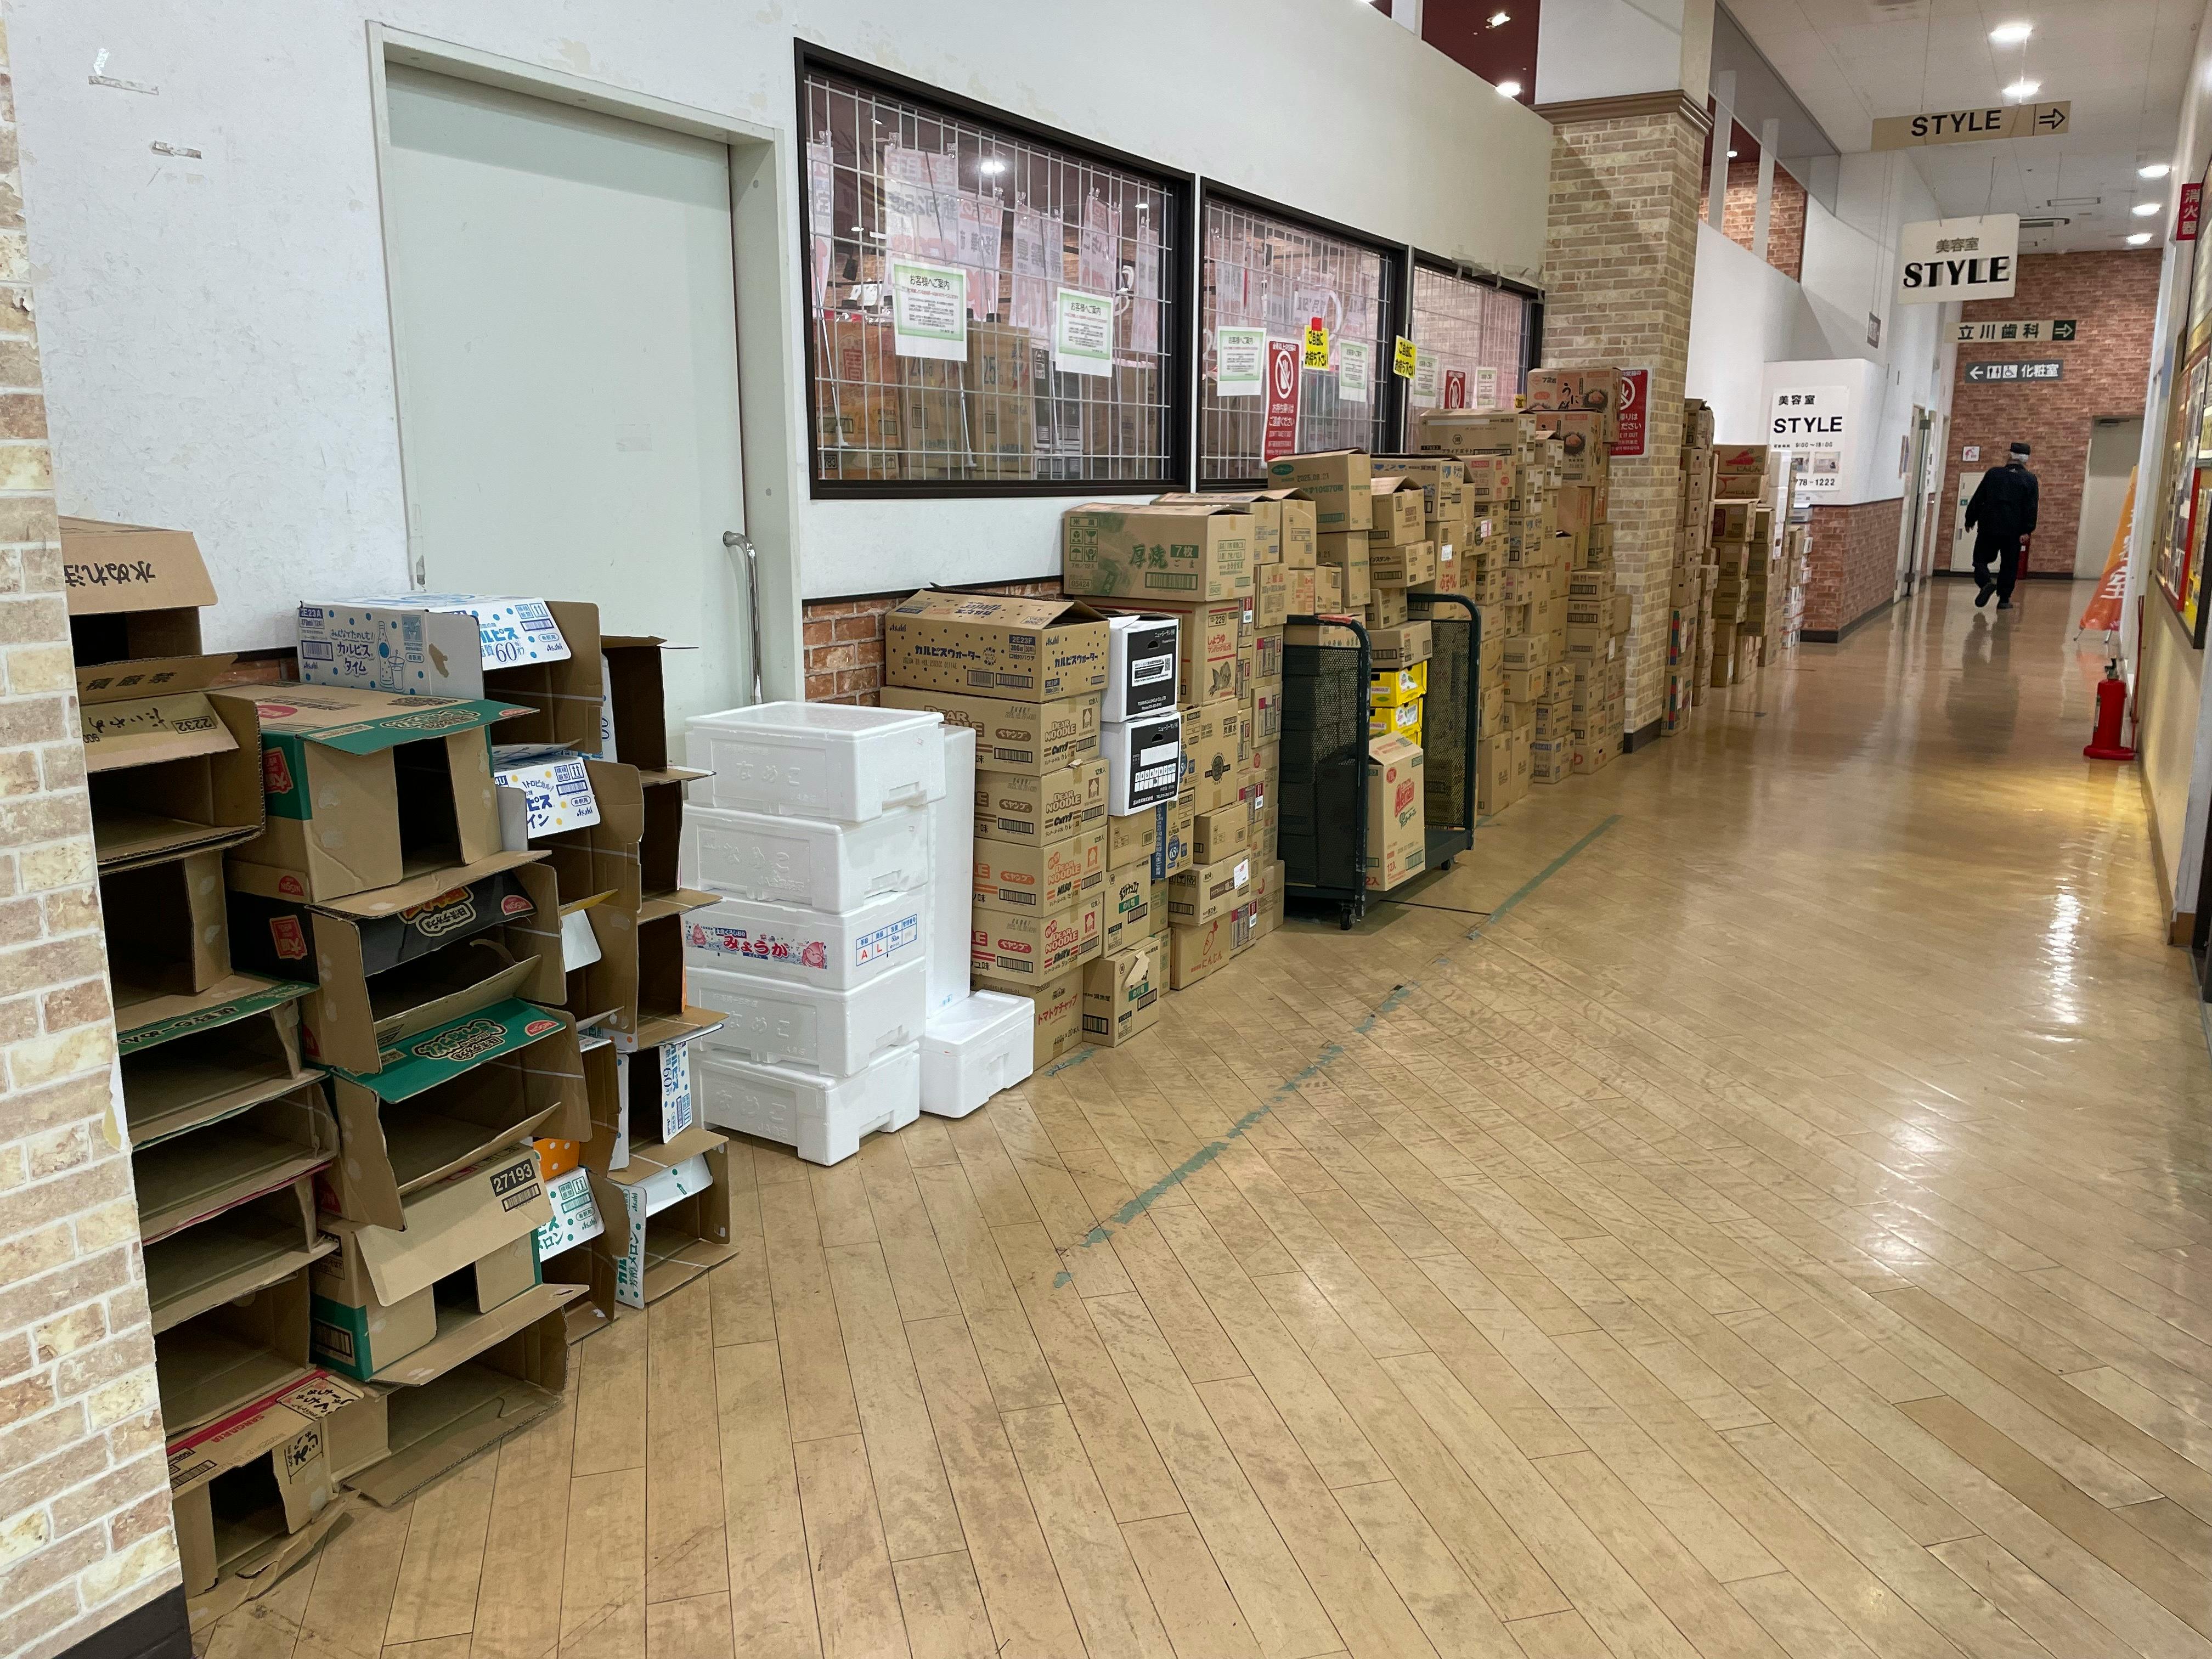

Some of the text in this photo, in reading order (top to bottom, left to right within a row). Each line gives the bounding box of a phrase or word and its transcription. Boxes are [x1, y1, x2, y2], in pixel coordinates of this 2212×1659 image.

[1911, 109, 2002, 137] STYLE
[1936, 236, 1979, 254] 美容室
[1903, 255, 2010, 288] STYLE
[910, 275, 950, 291] お客様へご案内
[1957, 323, 2040, 340] 立川歯科
[2021, 364, 2059, 379] 化粧室
[1778, 395, 1815, 405] 美容室
[1773, 416, 1843, 433] STYLE
[1129, 543, 1169, 569] 厚焼
[1174, 545, 1194, 558] 7枚
[1071, 579, 1092, 589] 05424
[889, 623, 906, 632] Asahi
[546, 643, 563, 652] Asahi
[1012, 636, 1033, 644] 2E23F
[1045, 635, 1059, 647] Asahi
[1207, 634, 1226, 646] しょうゆ
[337, 641, 371, 657] カルピス
[915, 645, 981, 661] カルピスウォーター
[345, 657, 367, 675] タイム
[1054, 652, 1099, 668] カルピスウォーター
[176, 718, 212, 732] 2232
[1045, 723, 1076, 742] NOODLE
[1052, 719, 1070, 731] DEAR
[997, 729, 1027, 741] ペヤング
[1051, 742, 1069, 755] Curry
[1053, 789, 1075, 802] DEAR
[577, 806, 593, 817] Asahi
[1000, 800, 1029, 812] ペヤング
[1046, 794, 1081, 814] NOODLE
[1053, 811, 1073, 826] Curry
[1056, 860, 1075, 873] DEAR
[1003, 872, 1028, 882] ペヤング
[1047, 864, 1081, 885] NOODLE
[1052, 927, 1072, 941] DEAR
[723, 935, 789, 958] みょうが
[1000, 940, 1027, 951] ペヤング
[1045, 930, 1079, 955] NOODLE
[861, 944, 883, 961] A L
[1201, 951, 1222, 970] にんじん
[1037, 992, 1079, 1026] トマトケチャップ
[493, 1163, 533, 1193] 27193
[582, 1217, 597, 1230] Asahi
[210, 1414, 265, 1443] SANGARIA
